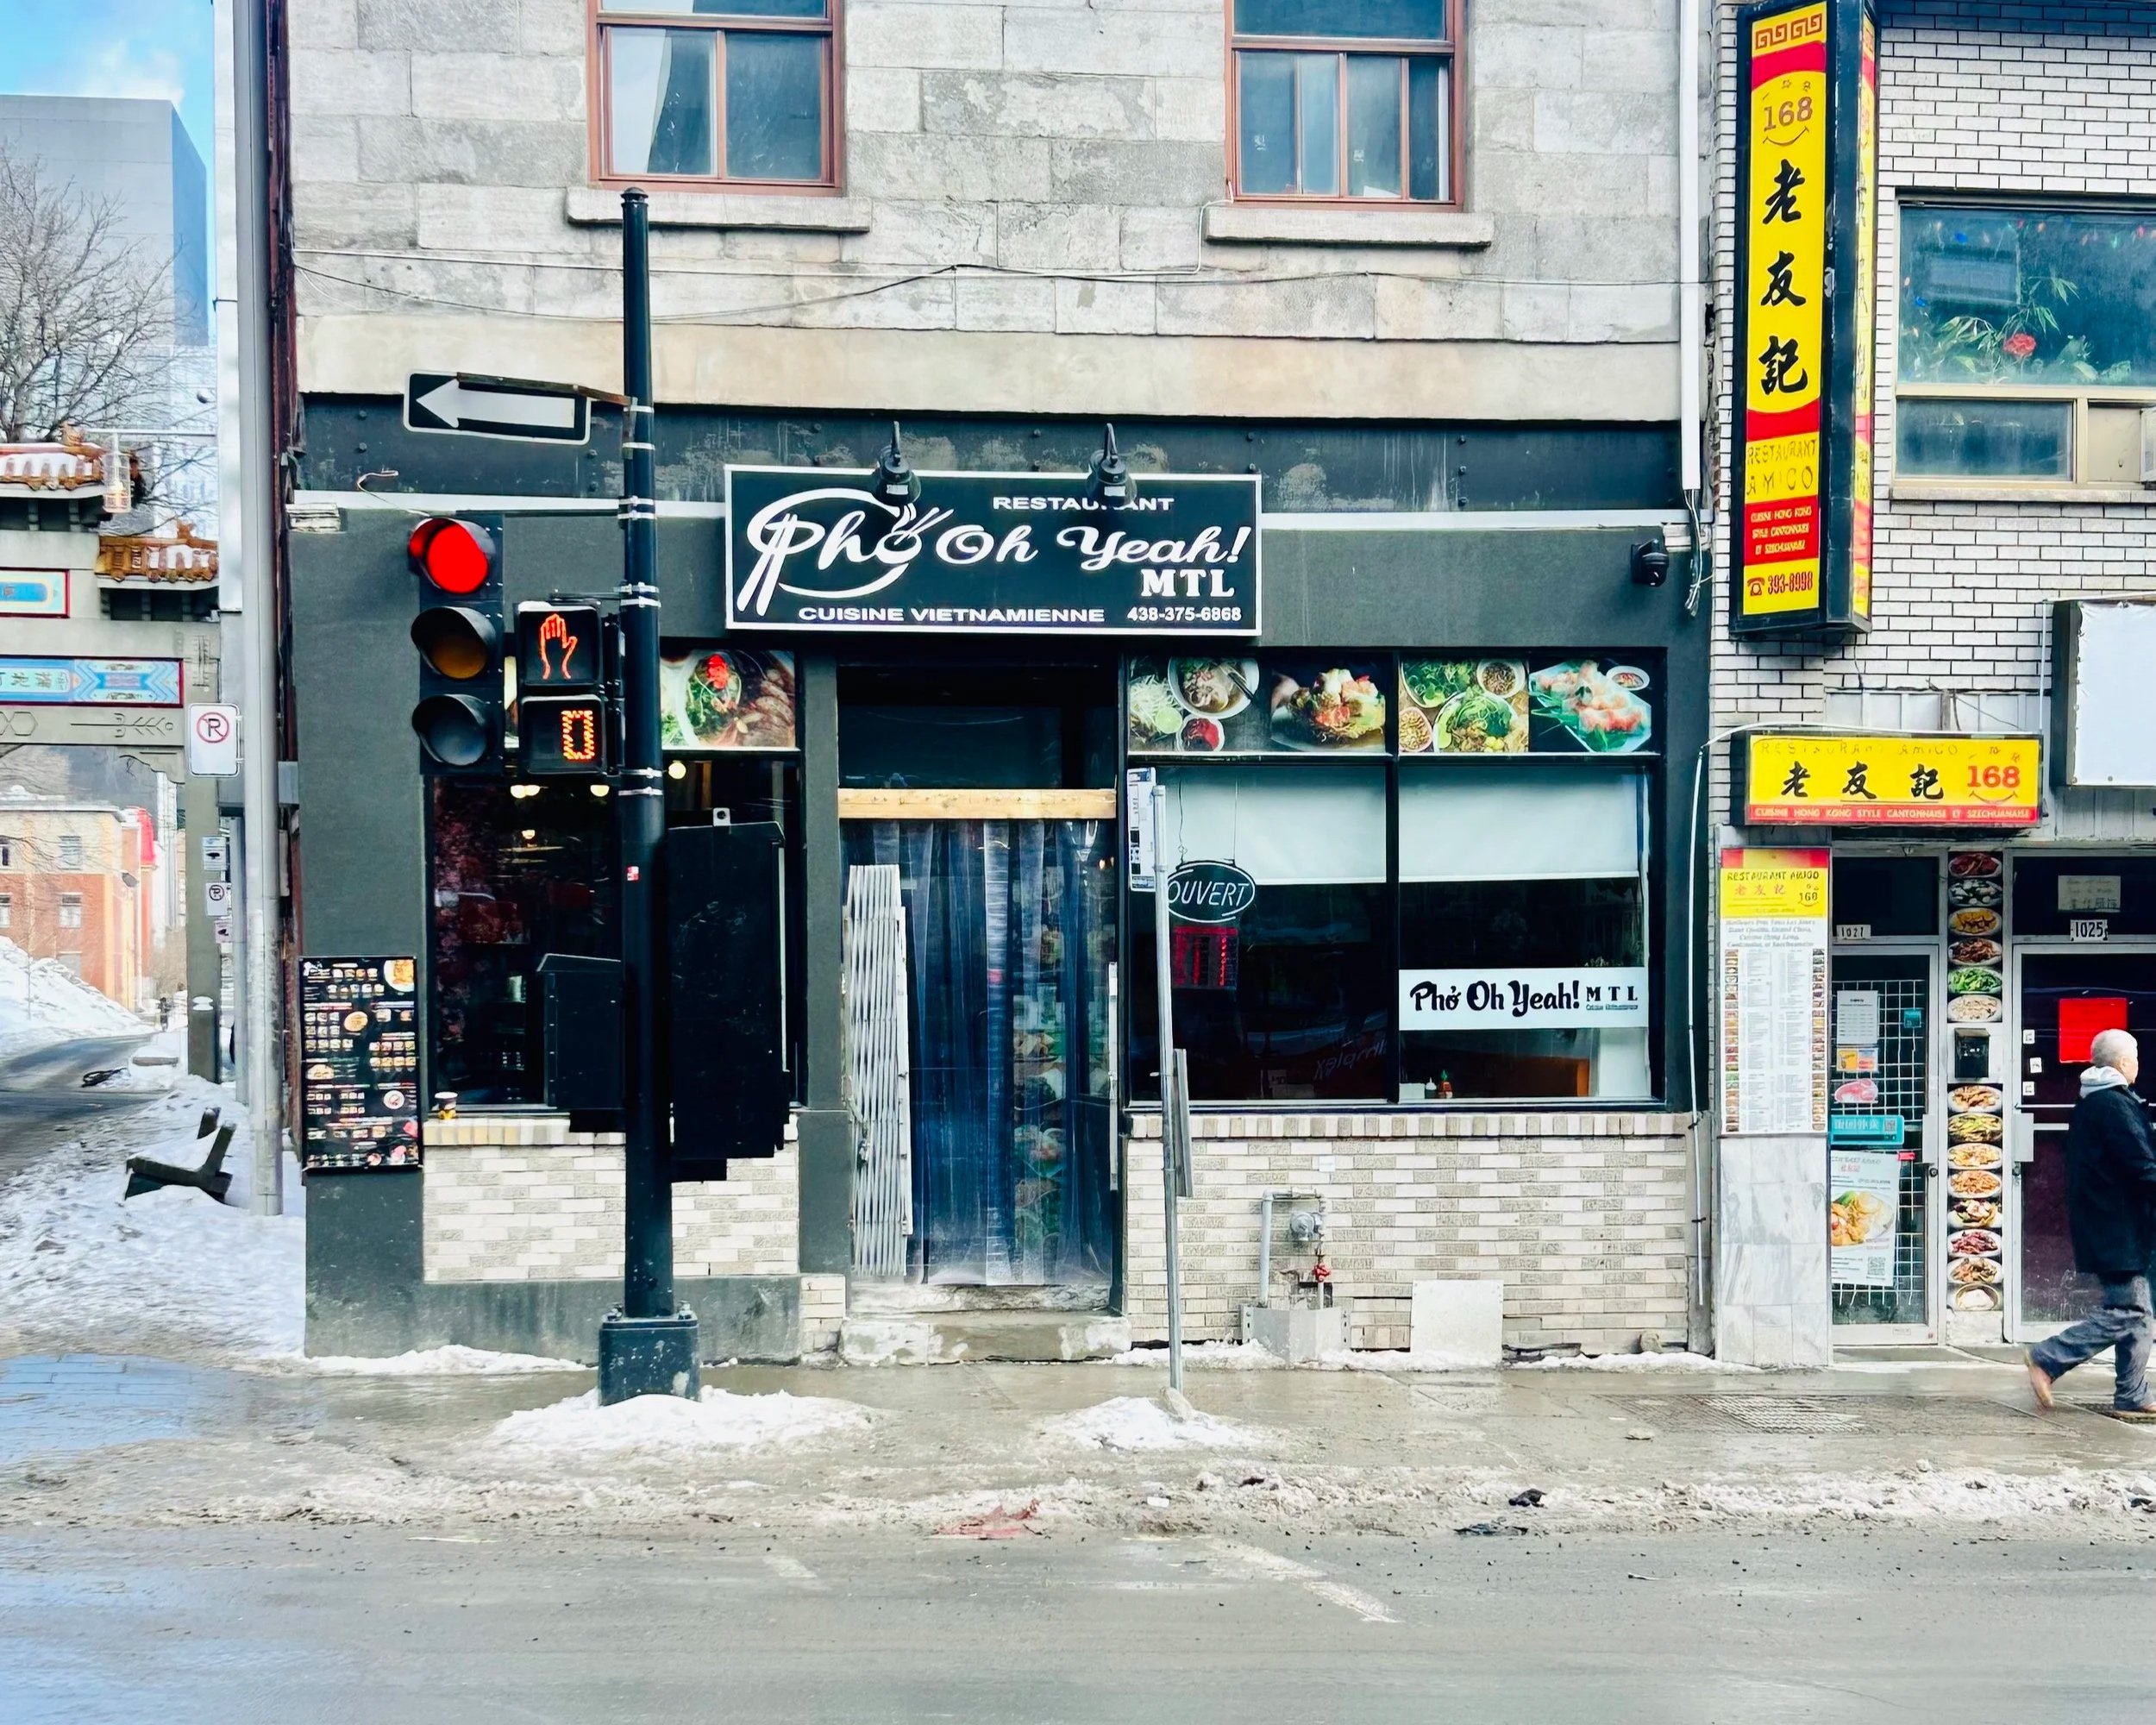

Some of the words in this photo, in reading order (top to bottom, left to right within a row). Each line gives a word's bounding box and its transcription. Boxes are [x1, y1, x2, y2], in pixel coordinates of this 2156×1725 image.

[1764, 97, 1813, 131] 168
[1758, 159, 1808, 395] 老友記
[993, 497, 1175, 511] RESTAUANT
[936, 524, 1038, 566] Oh
[1057, 525, 1253, 570] Yeah!
[1140, 568, 1235, 598] MTL
[799, 606, 905, 622] CUISINE
[910, 606, 1105, 623] VIETNAMIENNE
[1127, 606, 1243, 623] 438-375-6868
[1781, 761, 1944, 800] 老友記
[1967, 765, 2021, 788] 168
[1727, 871, 1786, 881] RESTAURANT
[1168, 880, 1250, 906] OUVERT
[2076, 921, 2103, 938] 1025
[1466, 980, 1505, 1011] Oh
[1509, 980, 1580, 1017] Yeah!
